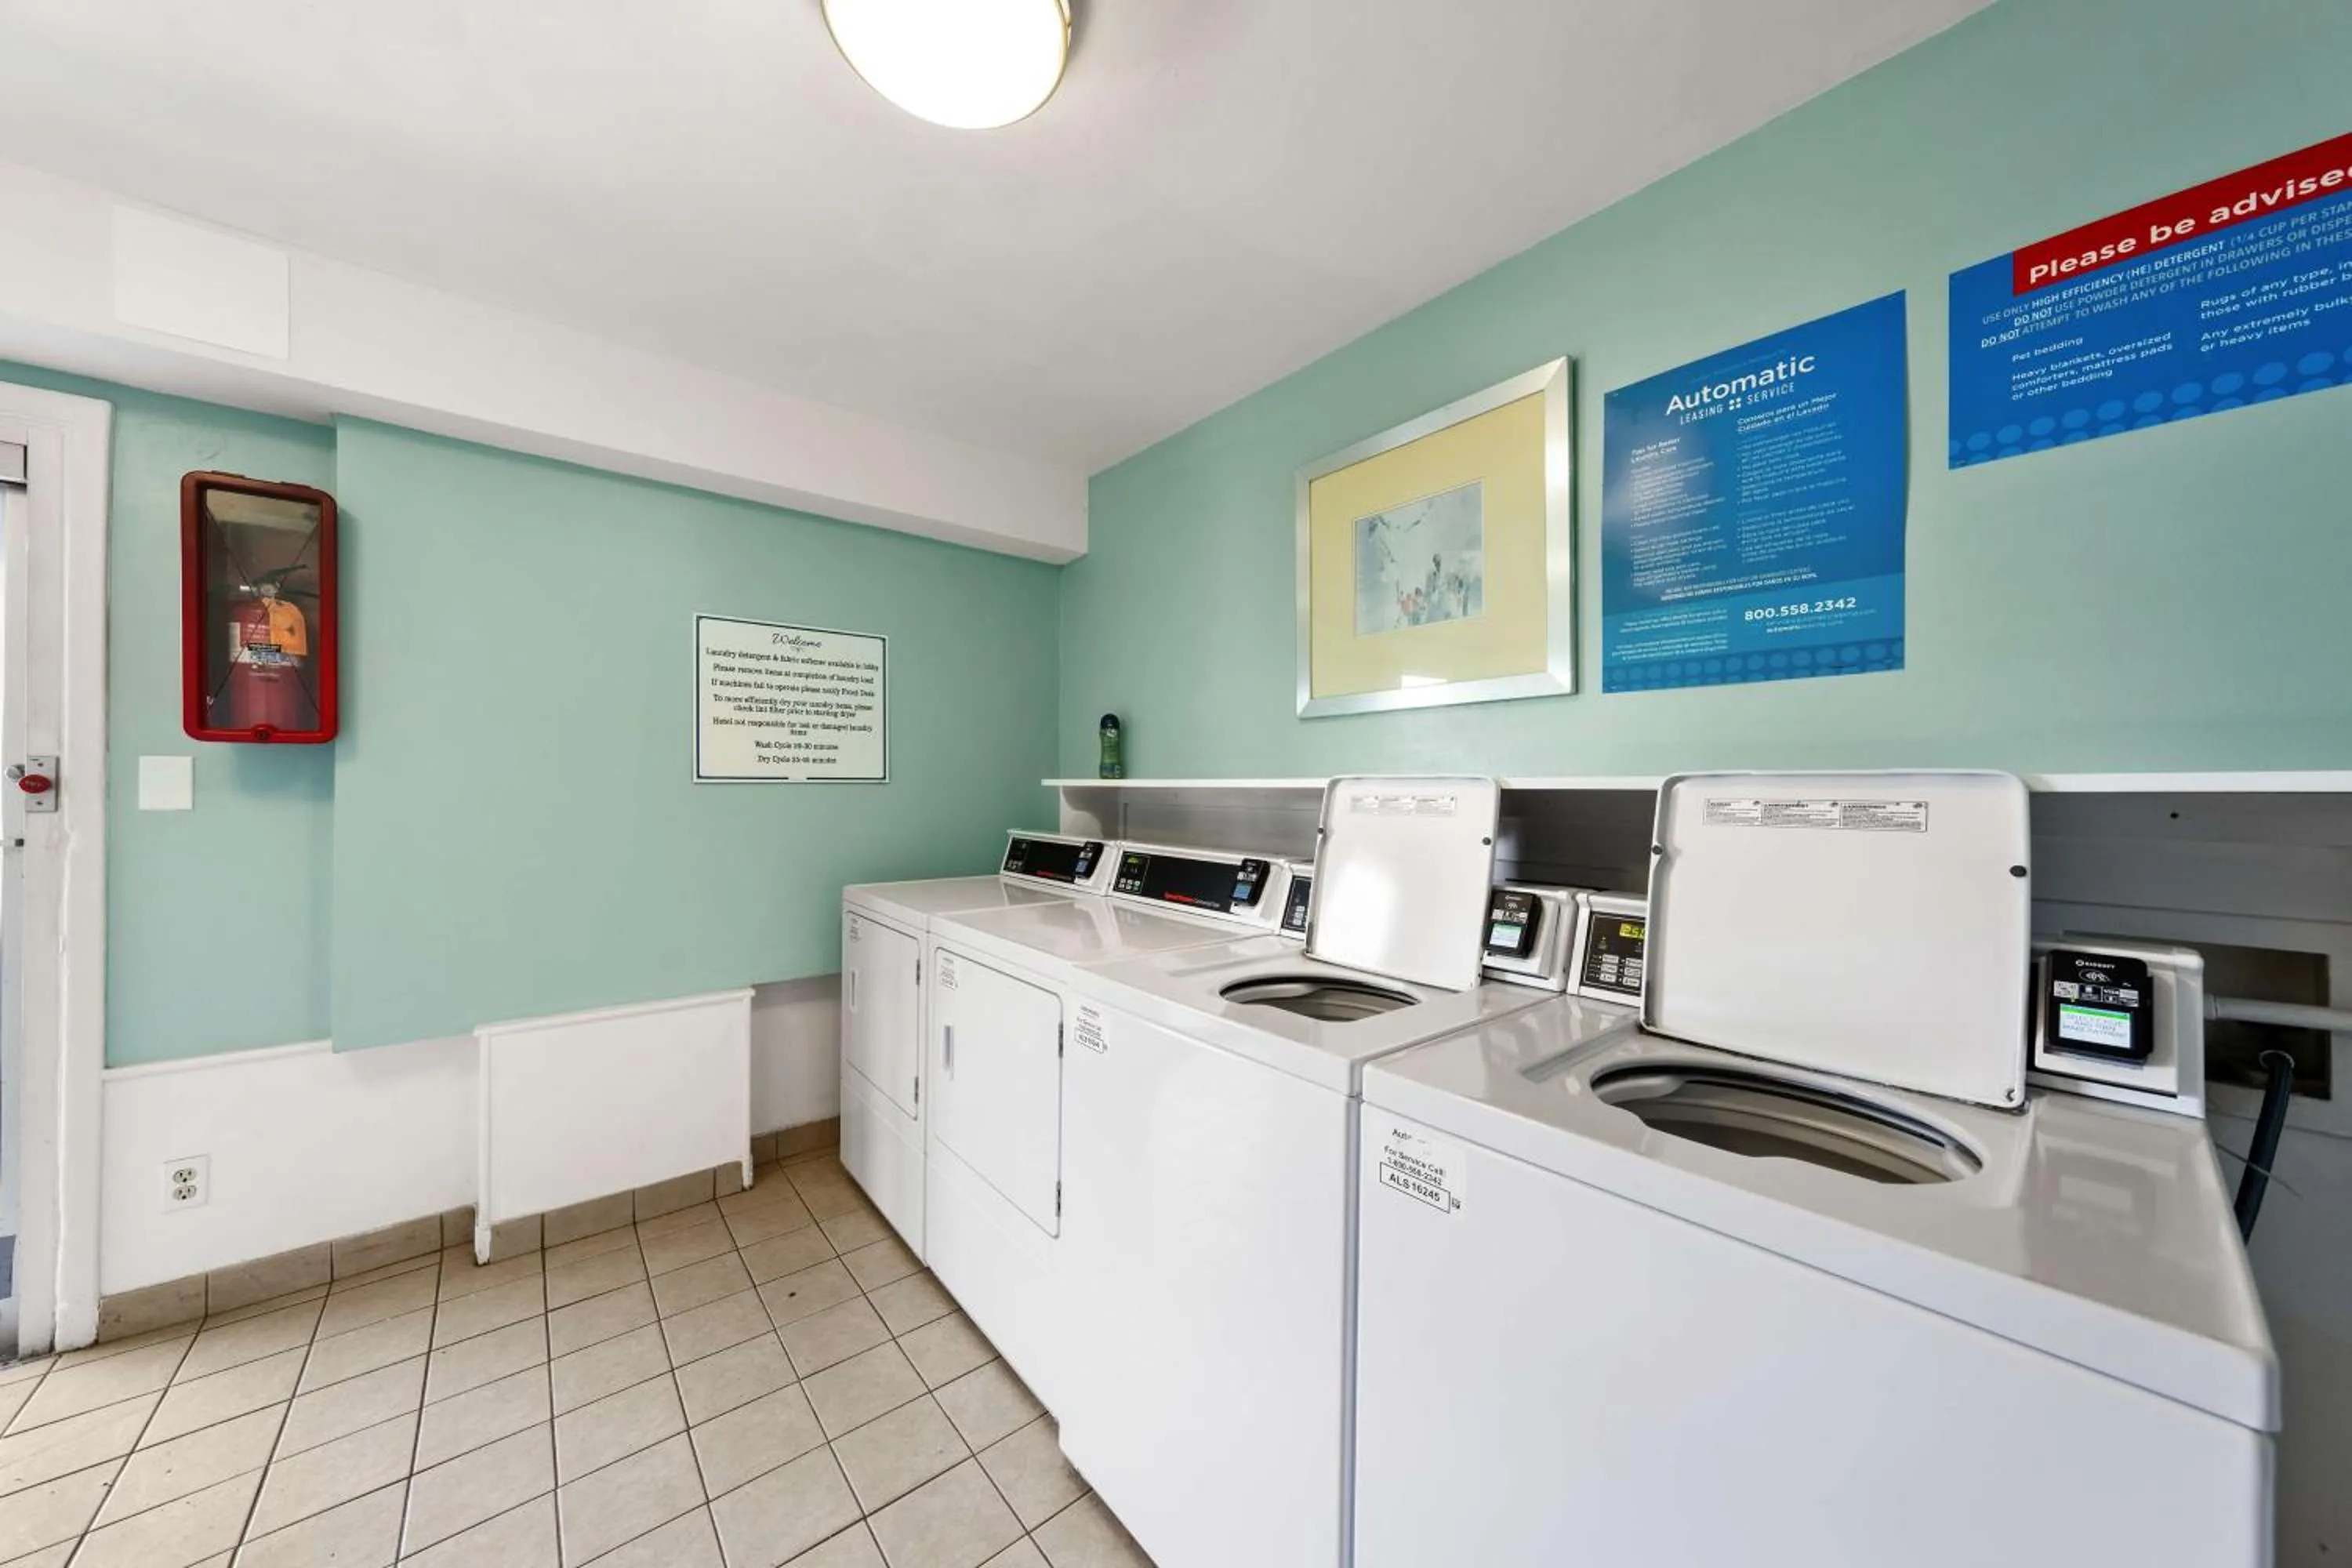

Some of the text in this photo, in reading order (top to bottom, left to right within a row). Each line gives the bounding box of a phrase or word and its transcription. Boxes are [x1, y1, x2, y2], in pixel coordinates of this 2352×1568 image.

[2029, 237, 2137, 285] Please
[2150, 218, 2196, 244] be
[1981, 310, 2002, 325] USE
[2003, 303, 2030, 319] ONLY
[2031, 294, 2060, 310] HIGH
[2062, 273, 2125, 303] EFFICIENCY
[2127, 264, 2151, 281] (HE)
[2154, 240, 2225, 270] DETERGENT
[2258, 221, 2287, 238] CUP
[2291, 212, 2318, 228] PER
[2013, 314, 2031, 327] DO
[2032, 307, 2053, 322] NOT
[2055, 300, 2075, 314] USE
[2078, 283, 2128, 306] POWDER
[2130, 263, 2201, 290] DETERGENT
[2201, 257, 2215, 270] IN
[2217, 234, 2284, 263] DRAWERS
[2286, 228, 2308, 244] OR
[1981, 336, 1997, 348] DO
[1999, 328, 2021, 344] NOT
[2021, 312, 2071, 336] ATTEMPT
[2075, 307, 2091, 320] TO
[2092, 296, 2129, 314] WASH
[2130, 288, 2156, 303] ANY
[2158, 281, 2176, 294] OF
[2180, 272, 2206, 289] THE
[2207, 246, 2292, 280] FOLLOWING
[2295, 239, 2312, 254] IN
[2200, 303, 2241, 321] those
[2245, 292, 2278, 308] with
[2282, 277, 2337, 298] rubber
[2201, 294, 2237, 310] Rugs
[2241, 286, 2257, 298] of
[2260, 278, 2288, 294] any
[2292, 267, 2333, 284] type,
[2200, 327, 2230, 342] Any
[2233, 307, 2310, 334] extremely
[2200, 318, 2312, 353] or heavy items
[2011, 336, 2084, 363] Pet bedding
[2011, 332, 2172, 383] Heavy blankets, oversized
[2011, 343, 2174, 391] comforters, mattress pads
[1664, 353, 1818, 417] Automatic
[2011, 368, 2114, 401] or other bedding
[1679, 381, 1796, 426] LEASING SERVICE
[1776, 404, 1797, 416] para
[1744, 597, 1857, 622] 800.558.2342
[706, 647, 736, 659] Laundry
[738, 652, 772, 662] detergent
[771, 632, 822, 648] Welcome
[713, 662, 735, 672] Please
[713, 693, 724, 702] To
[779, 697, 791, 708] dry
[713, 717, 733, 725] Hotel
[754, 740, 772, 749] Wash
[774, 741, 793, 750] Cycle
[757, 755, 771, 764] Dry
[772, 755, 791, 764] Cycle
[1384, 1145, 1398, 1156] For
[1398, 1151, 1427, 1169] Service
[1389, 1173, 1441, 1203] ALS 16245
